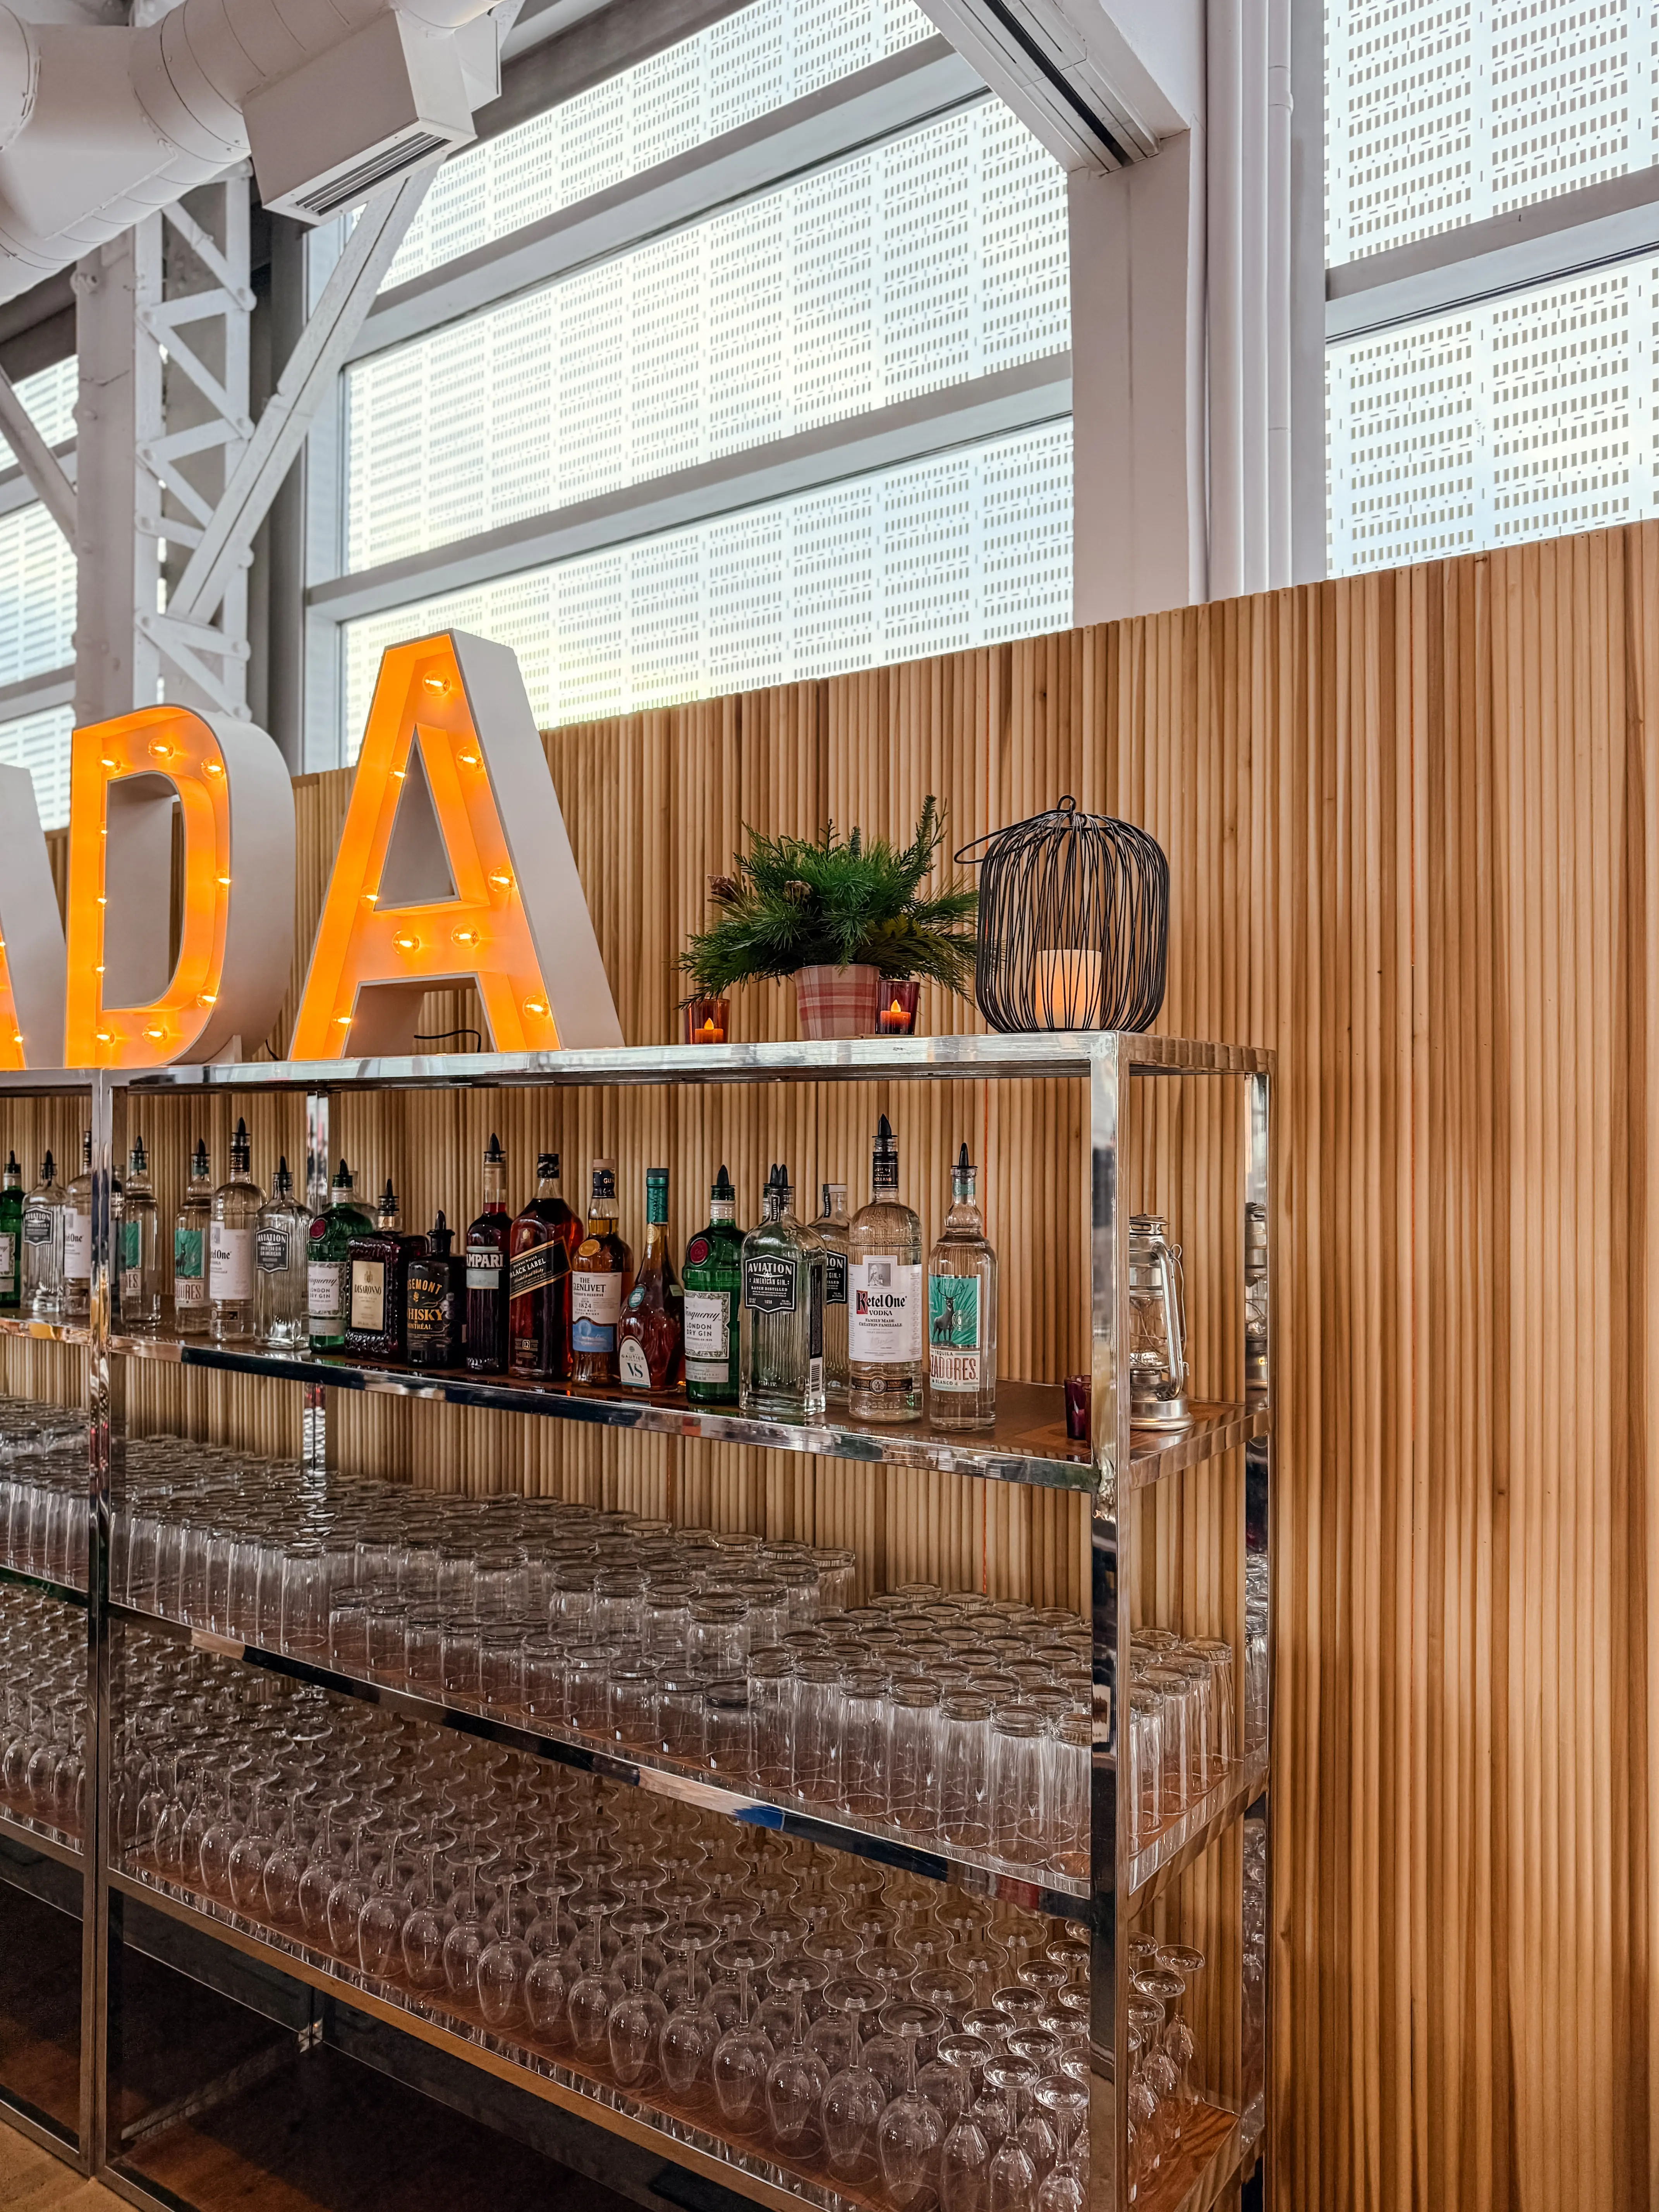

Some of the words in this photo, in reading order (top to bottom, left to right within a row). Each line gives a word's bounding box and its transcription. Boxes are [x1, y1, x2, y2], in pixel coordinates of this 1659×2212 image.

[0, 629, 624, 1071] DA
[258, 1233, 286, 1243] AVIATION
[217, 1250, 230, 1259] One
[510, 1266, 526, 1278] BLACK
[527, 1258, 546, 1270] LABEL
[748, 1263, 792, 1275] AVIATION
[354, 1284, 382, 1295] DISARONNO
[574, 1283, 606, 1293] GLENLIVET
[857, 1292, 884, 1314] Ketel
[885, 1294, 906, 1308] One
[685, 1307, 720, 1321] Tanqueray
[626, 1362, 643, 1378] VS
